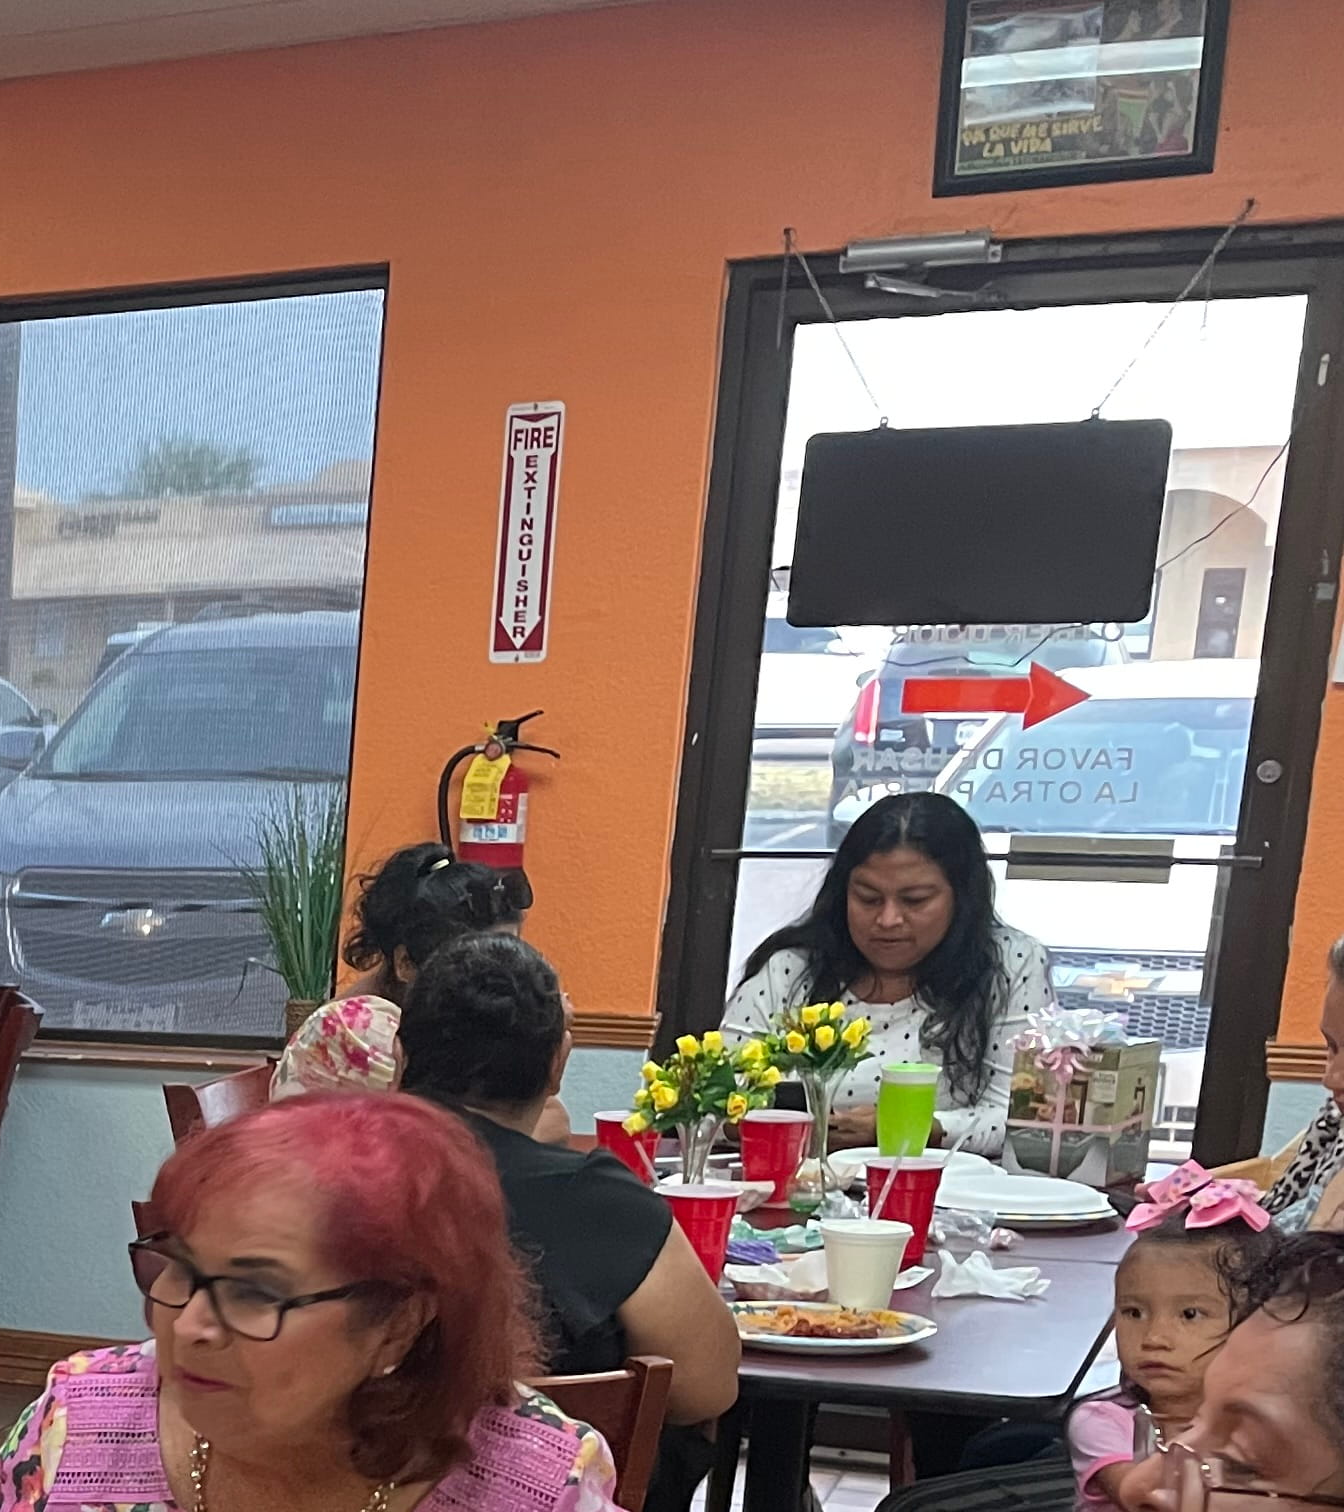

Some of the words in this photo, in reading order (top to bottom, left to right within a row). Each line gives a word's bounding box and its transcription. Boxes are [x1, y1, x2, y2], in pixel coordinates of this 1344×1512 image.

[982, 141, 1005, 158] LA
[1010, 137, 1052, 155] VIDA
[513, 426, 555, 451] FIRE
[512, 454, 539, 639] EXTINGUISHER
